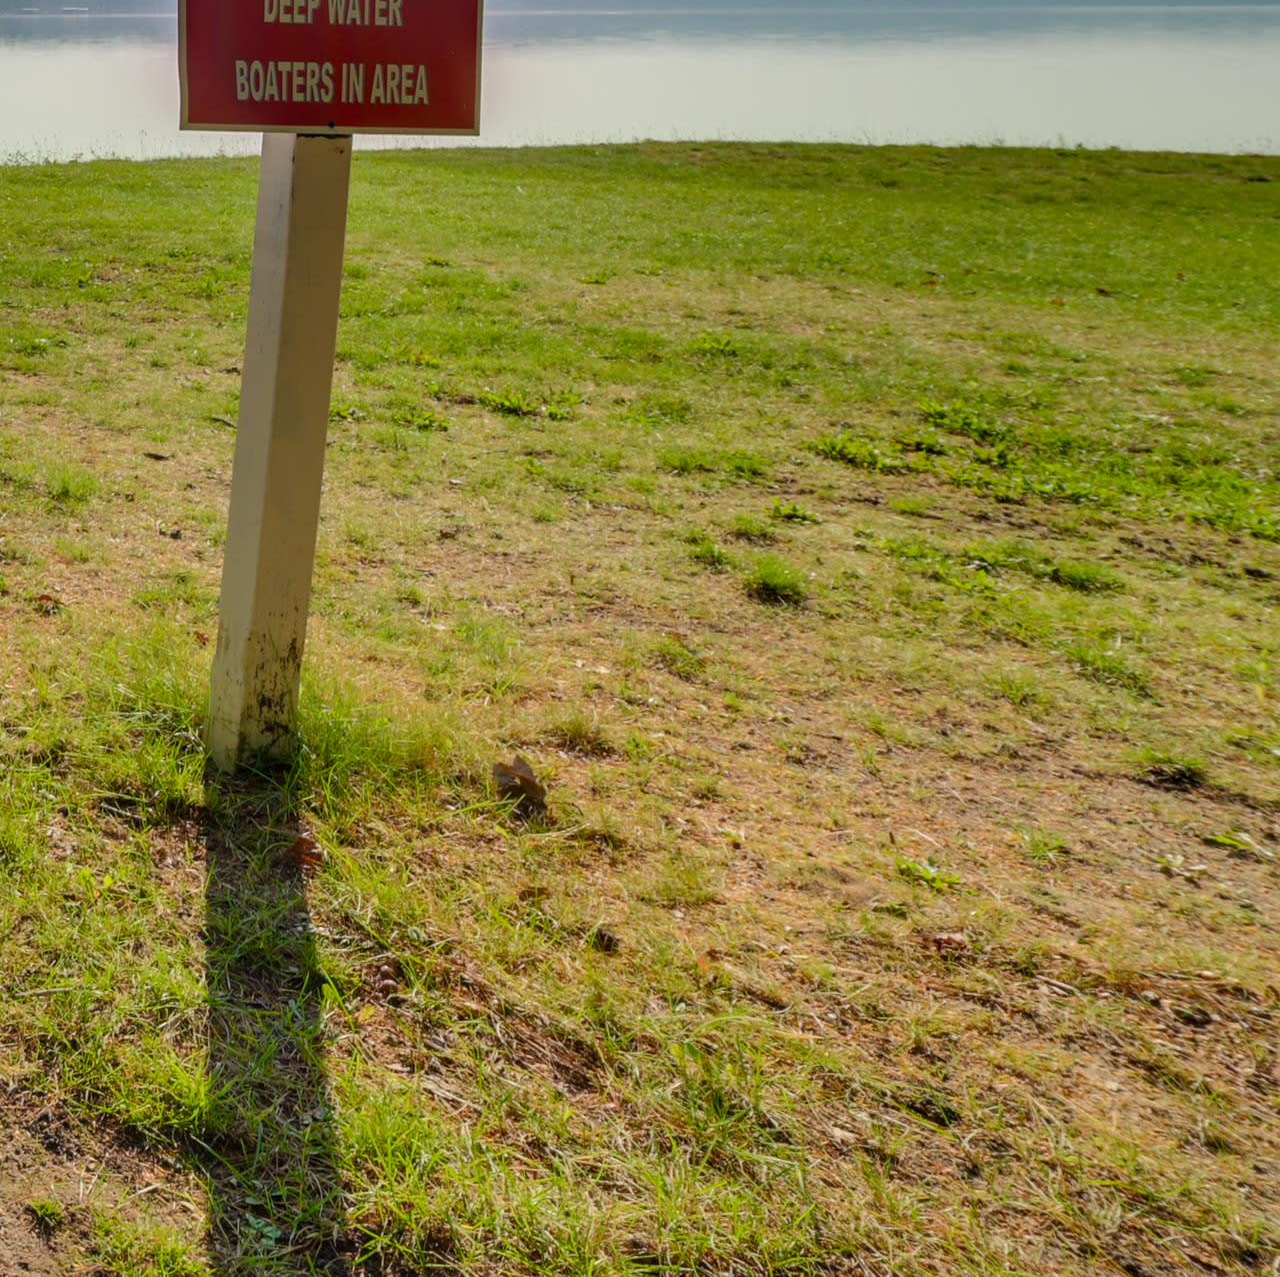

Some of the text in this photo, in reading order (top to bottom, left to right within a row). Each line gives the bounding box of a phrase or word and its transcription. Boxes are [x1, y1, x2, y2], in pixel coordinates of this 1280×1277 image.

[235, 60, 429, 106] BOATERS IN AREA
